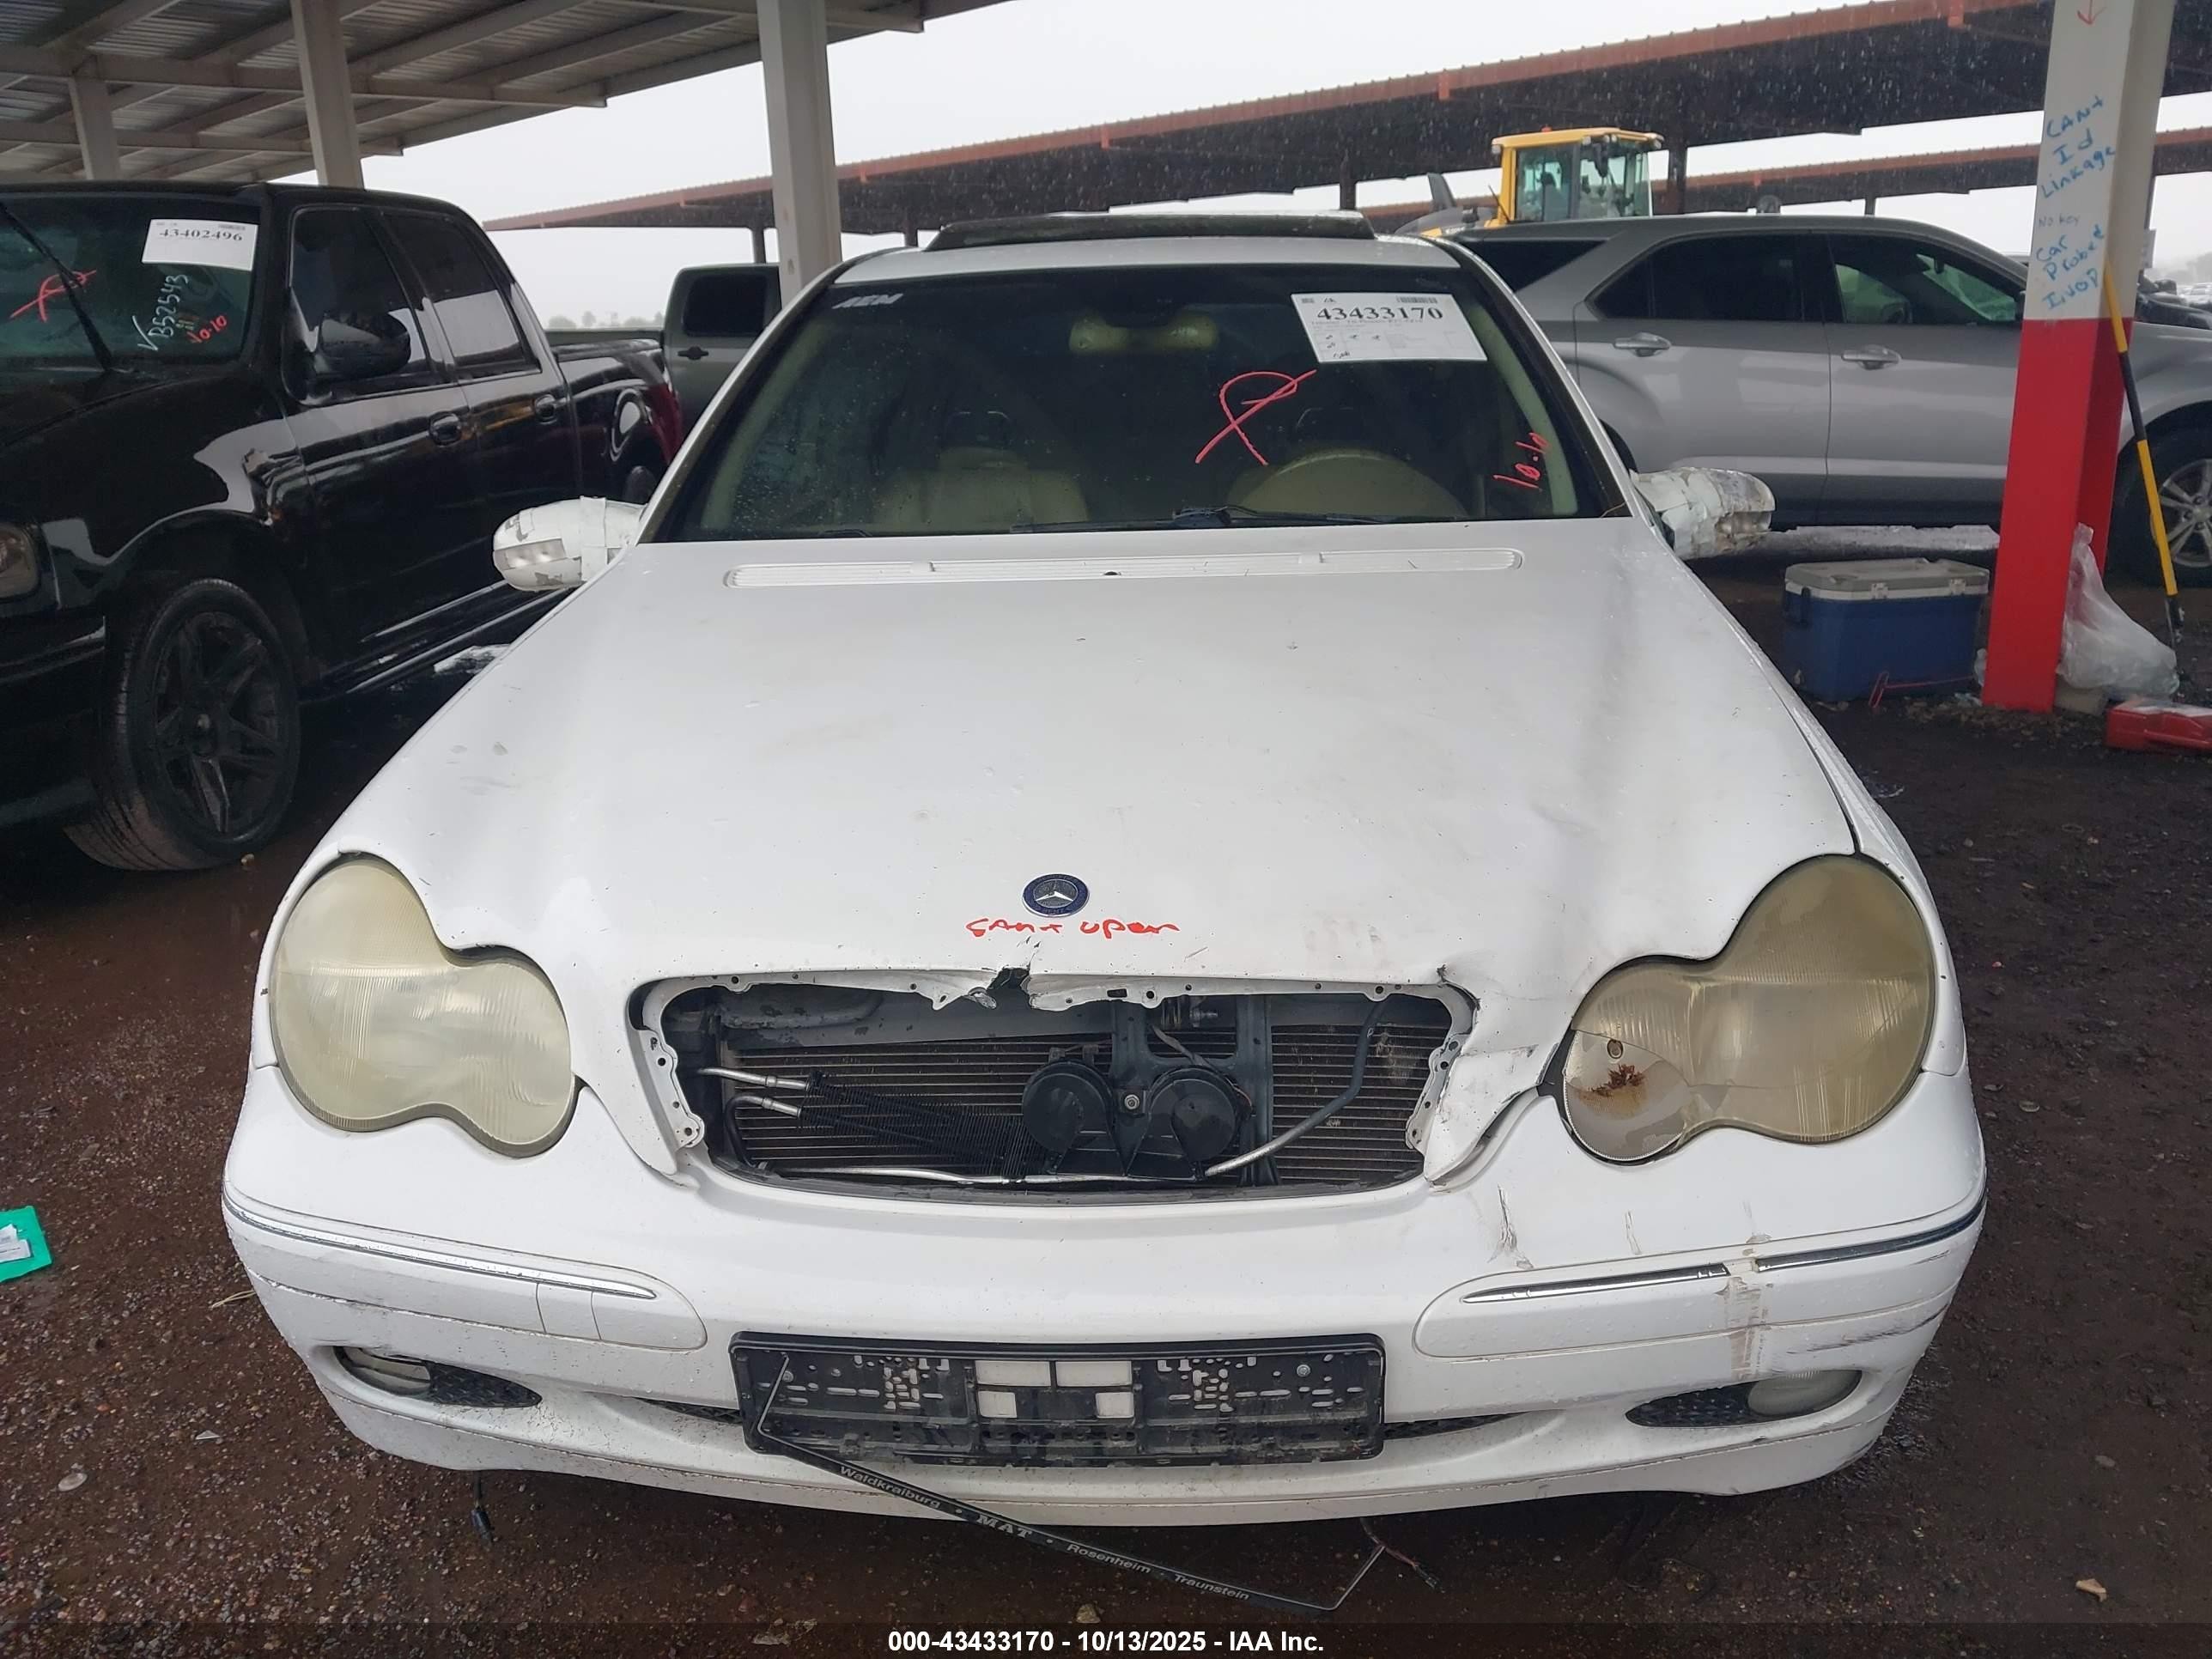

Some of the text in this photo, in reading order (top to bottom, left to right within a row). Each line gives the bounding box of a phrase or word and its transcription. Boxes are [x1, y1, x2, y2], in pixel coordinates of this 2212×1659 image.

[159, 228, 243, 241] 43402496
[2036, 234, 2069, 262] Car
[1316, 306, 1444, 321] 43433170
[839, 1465, 1250, 1601] Waldkraiburg MAT Rosenheim Traunstein
